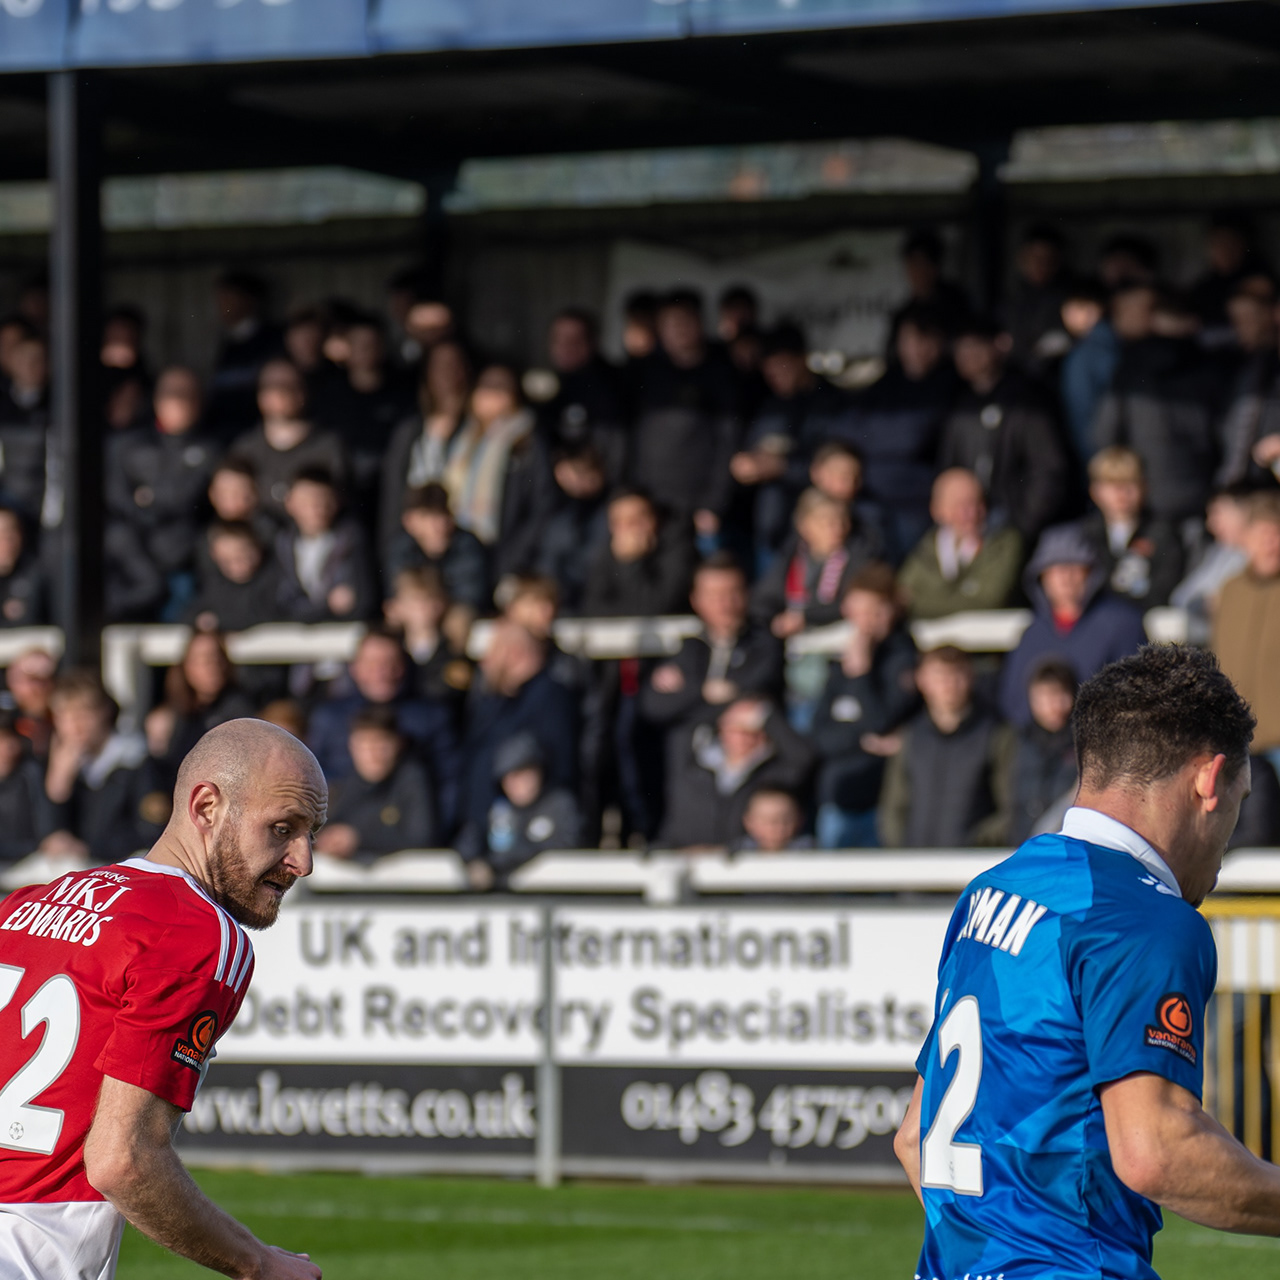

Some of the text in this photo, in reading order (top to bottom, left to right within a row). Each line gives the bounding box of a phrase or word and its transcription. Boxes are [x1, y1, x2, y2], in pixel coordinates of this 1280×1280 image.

[0, 901, 113, 947] EDWARDS
[40, 876, 132, 912] MKJ
[299, 912, 851, 970] UK and International
[629, 986, 928, 1051] Specialists
[183, 1070, 536, 1138] ww.lovetts.co.uk
[921, 989, 984, 1197] 2
